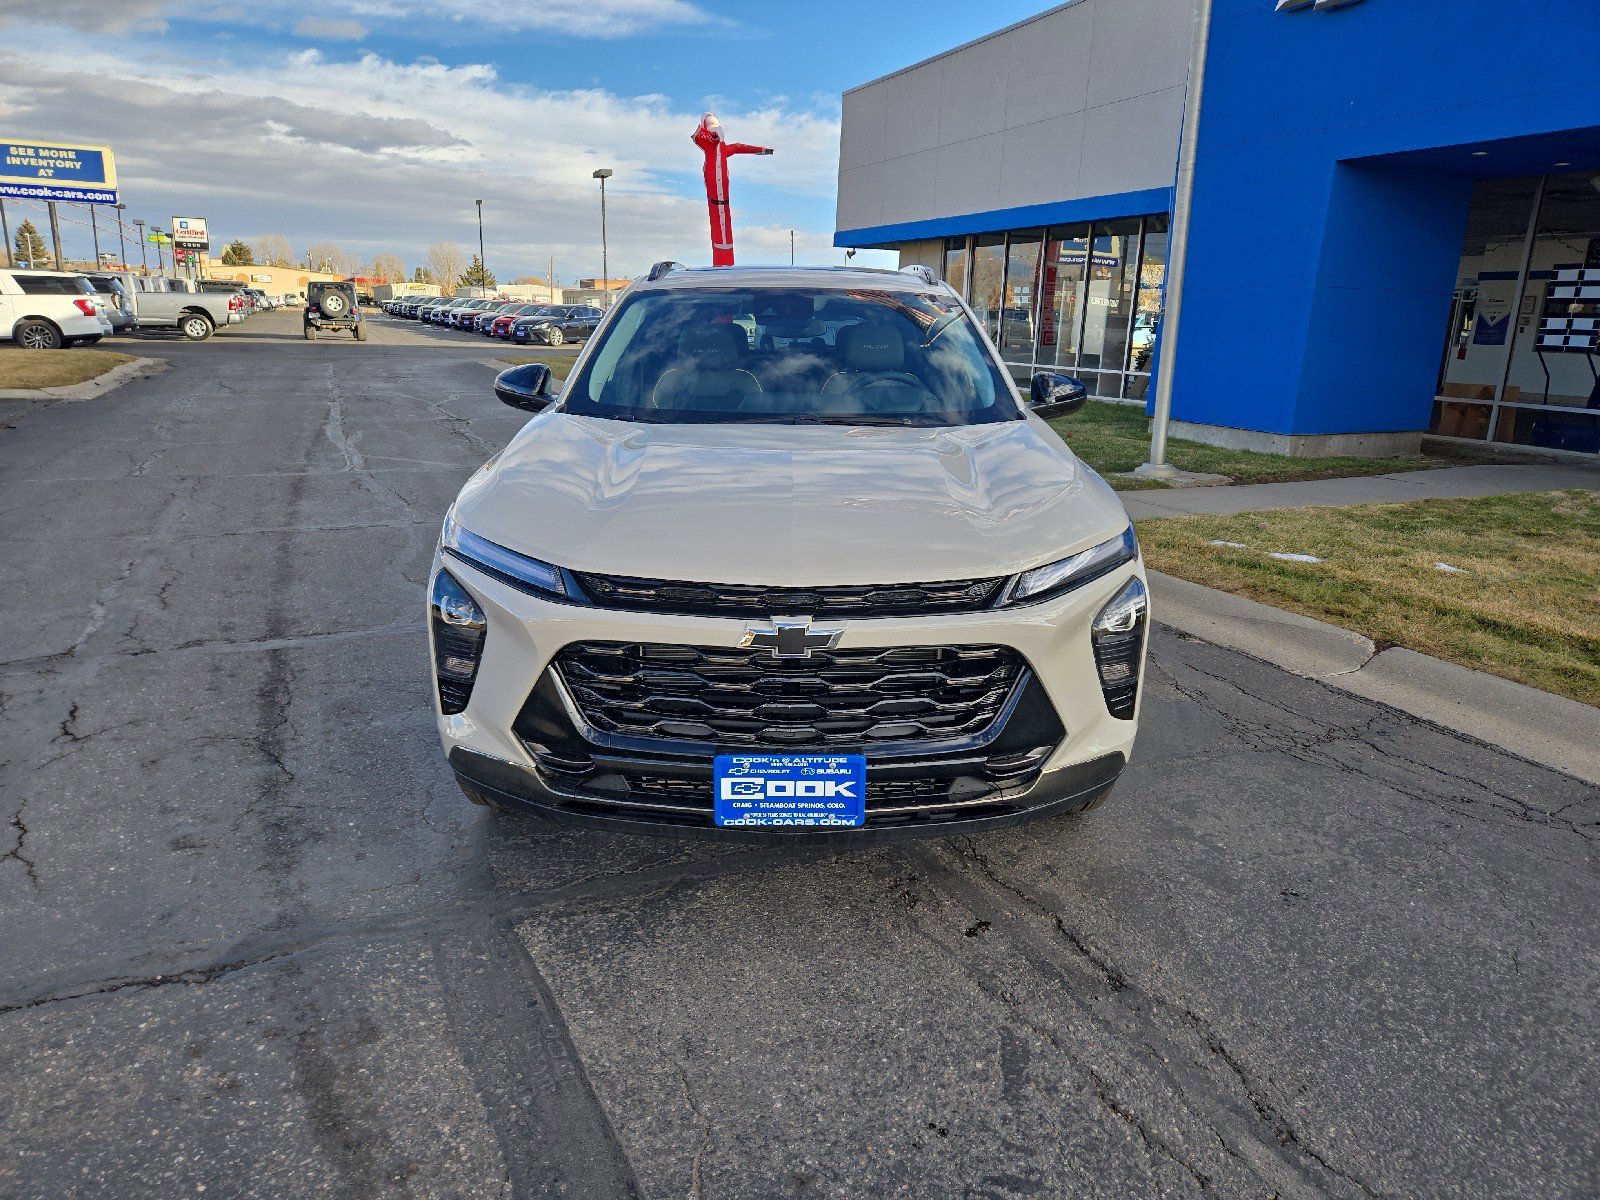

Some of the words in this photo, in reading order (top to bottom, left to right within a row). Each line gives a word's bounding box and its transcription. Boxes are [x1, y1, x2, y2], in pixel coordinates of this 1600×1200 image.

[9, 146, 35, 156] SEE
[39, 148, 76, 159] MORE
[6, 156, 82, 169] INVENTORY
[37, 168, 54, 177] AT
[720, 777, 858, 801] COOK
[723, 818, 856, 826] COOK-CARS.COM
